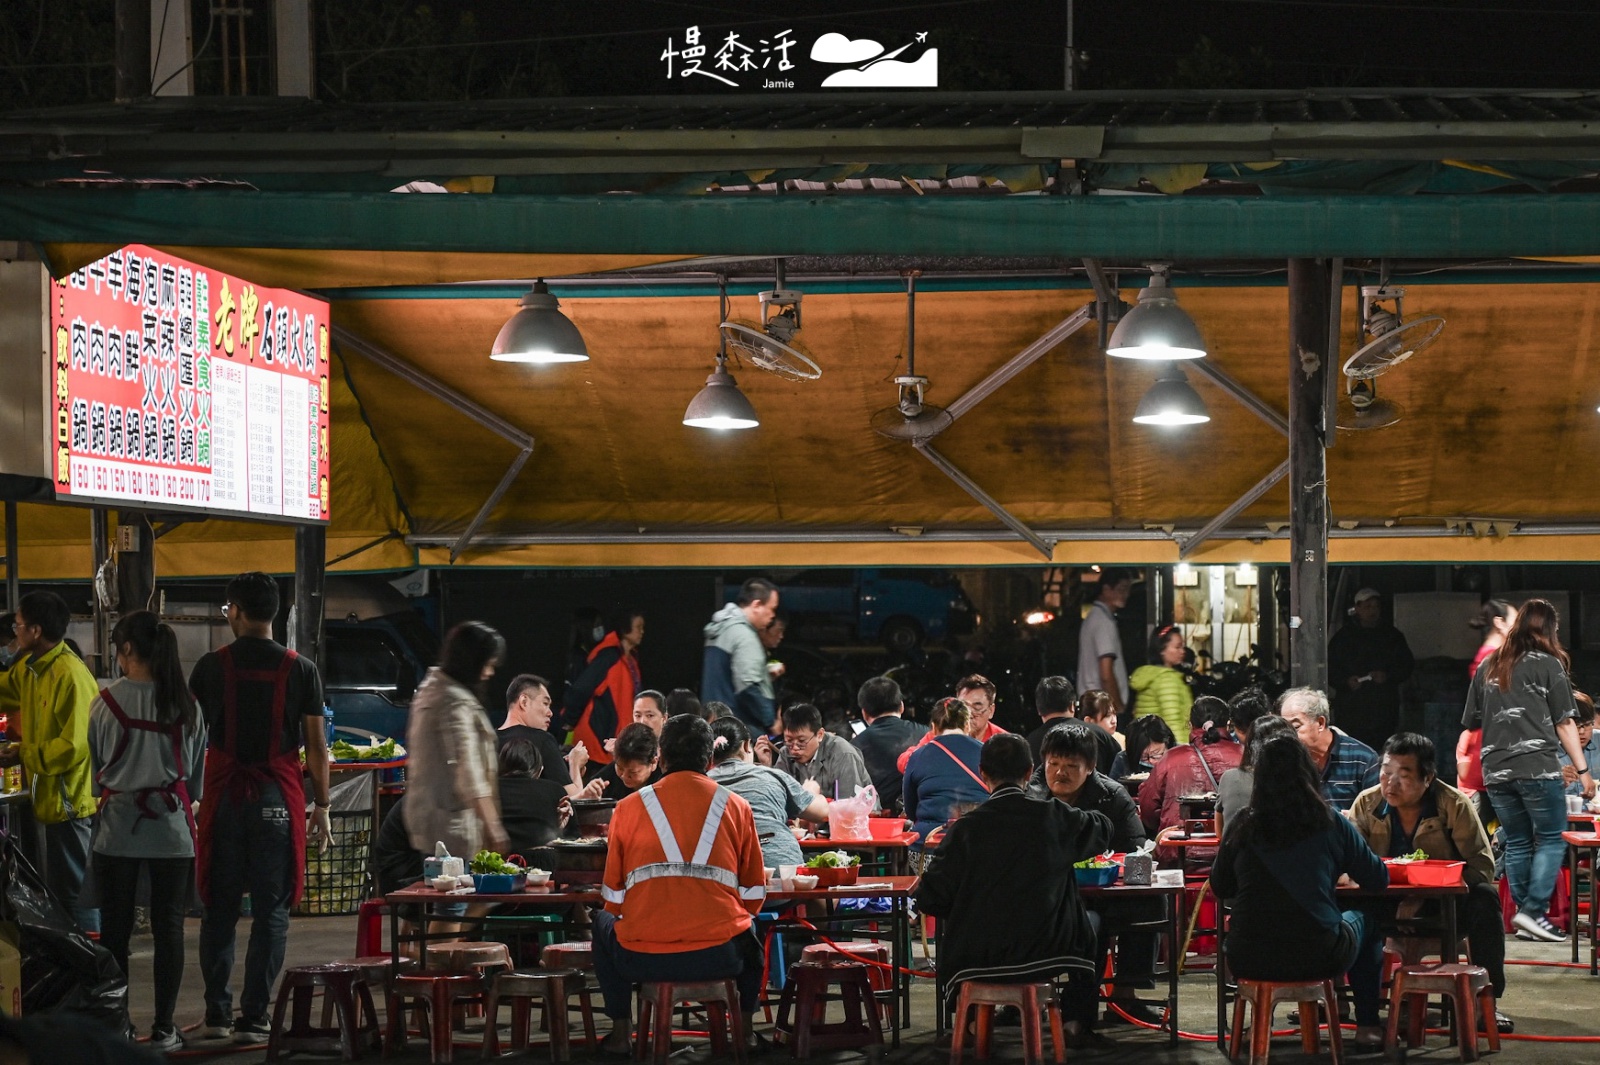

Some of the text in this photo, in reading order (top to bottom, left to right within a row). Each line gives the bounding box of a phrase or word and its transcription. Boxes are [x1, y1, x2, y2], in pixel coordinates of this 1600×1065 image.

[109, 252, 123, 456] 羊肉鍋
[126, 253, 141, 459] 海鮮鍋
[144, 258, 158, 460] 泡菜火鍋
[161, 264, 176, 463] 麻辣火鍋
[73, 464, 210, 502] 150 150 150 180 180 180 200 170
